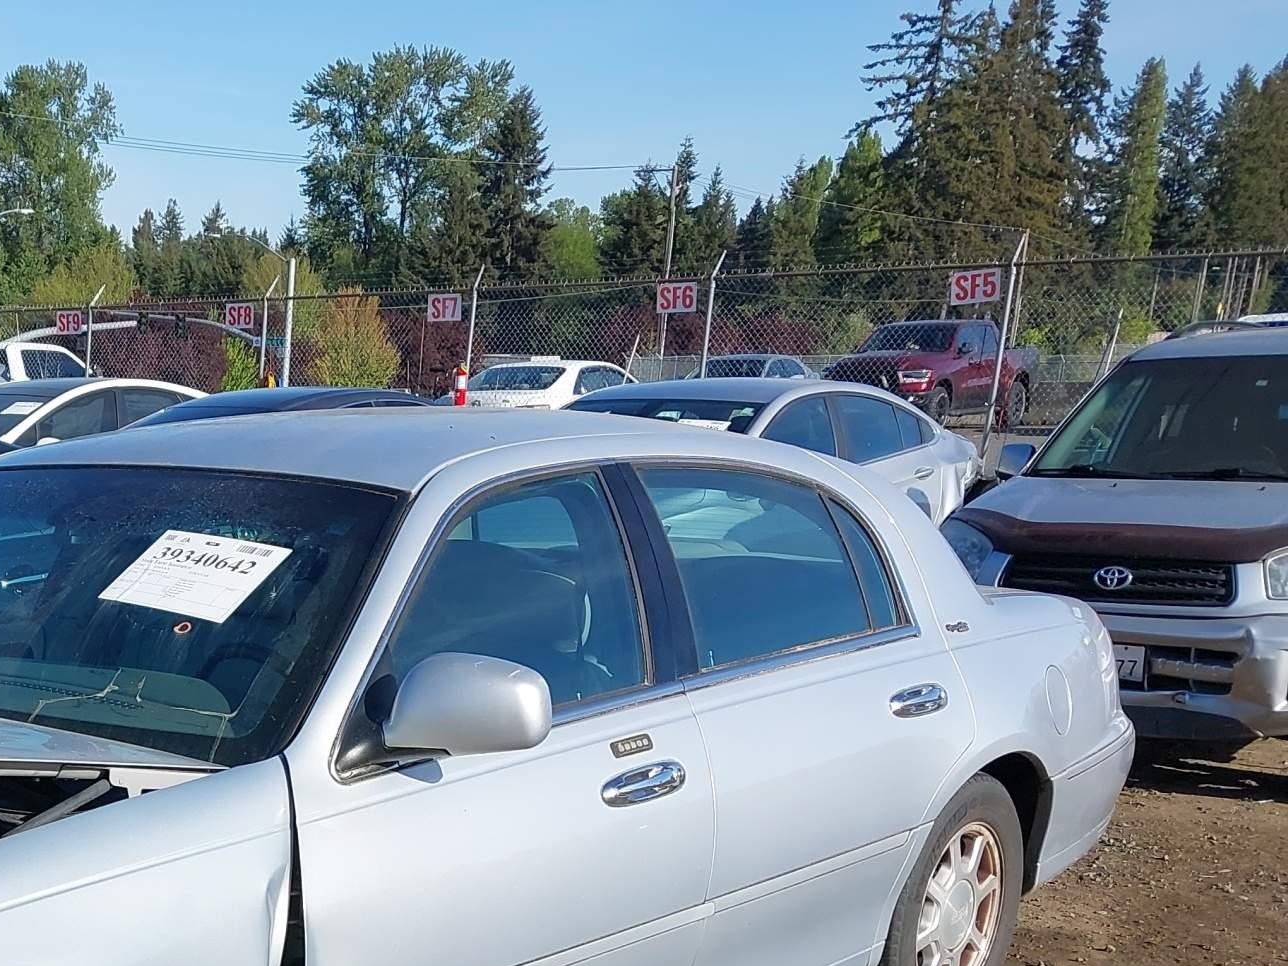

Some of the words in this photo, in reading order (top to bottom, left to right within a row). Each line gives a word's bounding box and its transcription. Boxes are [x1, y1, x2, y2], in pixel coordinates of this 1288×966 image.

[660, 285, 694, 310] SF6
[955, 271, 997, 301] SF5
[228, 305, 252, 326] SF8
[431, 297, 457, 320] SF7
[58, 312, 81, 332] SF9
[152, 546, 258, 575] 39340642
